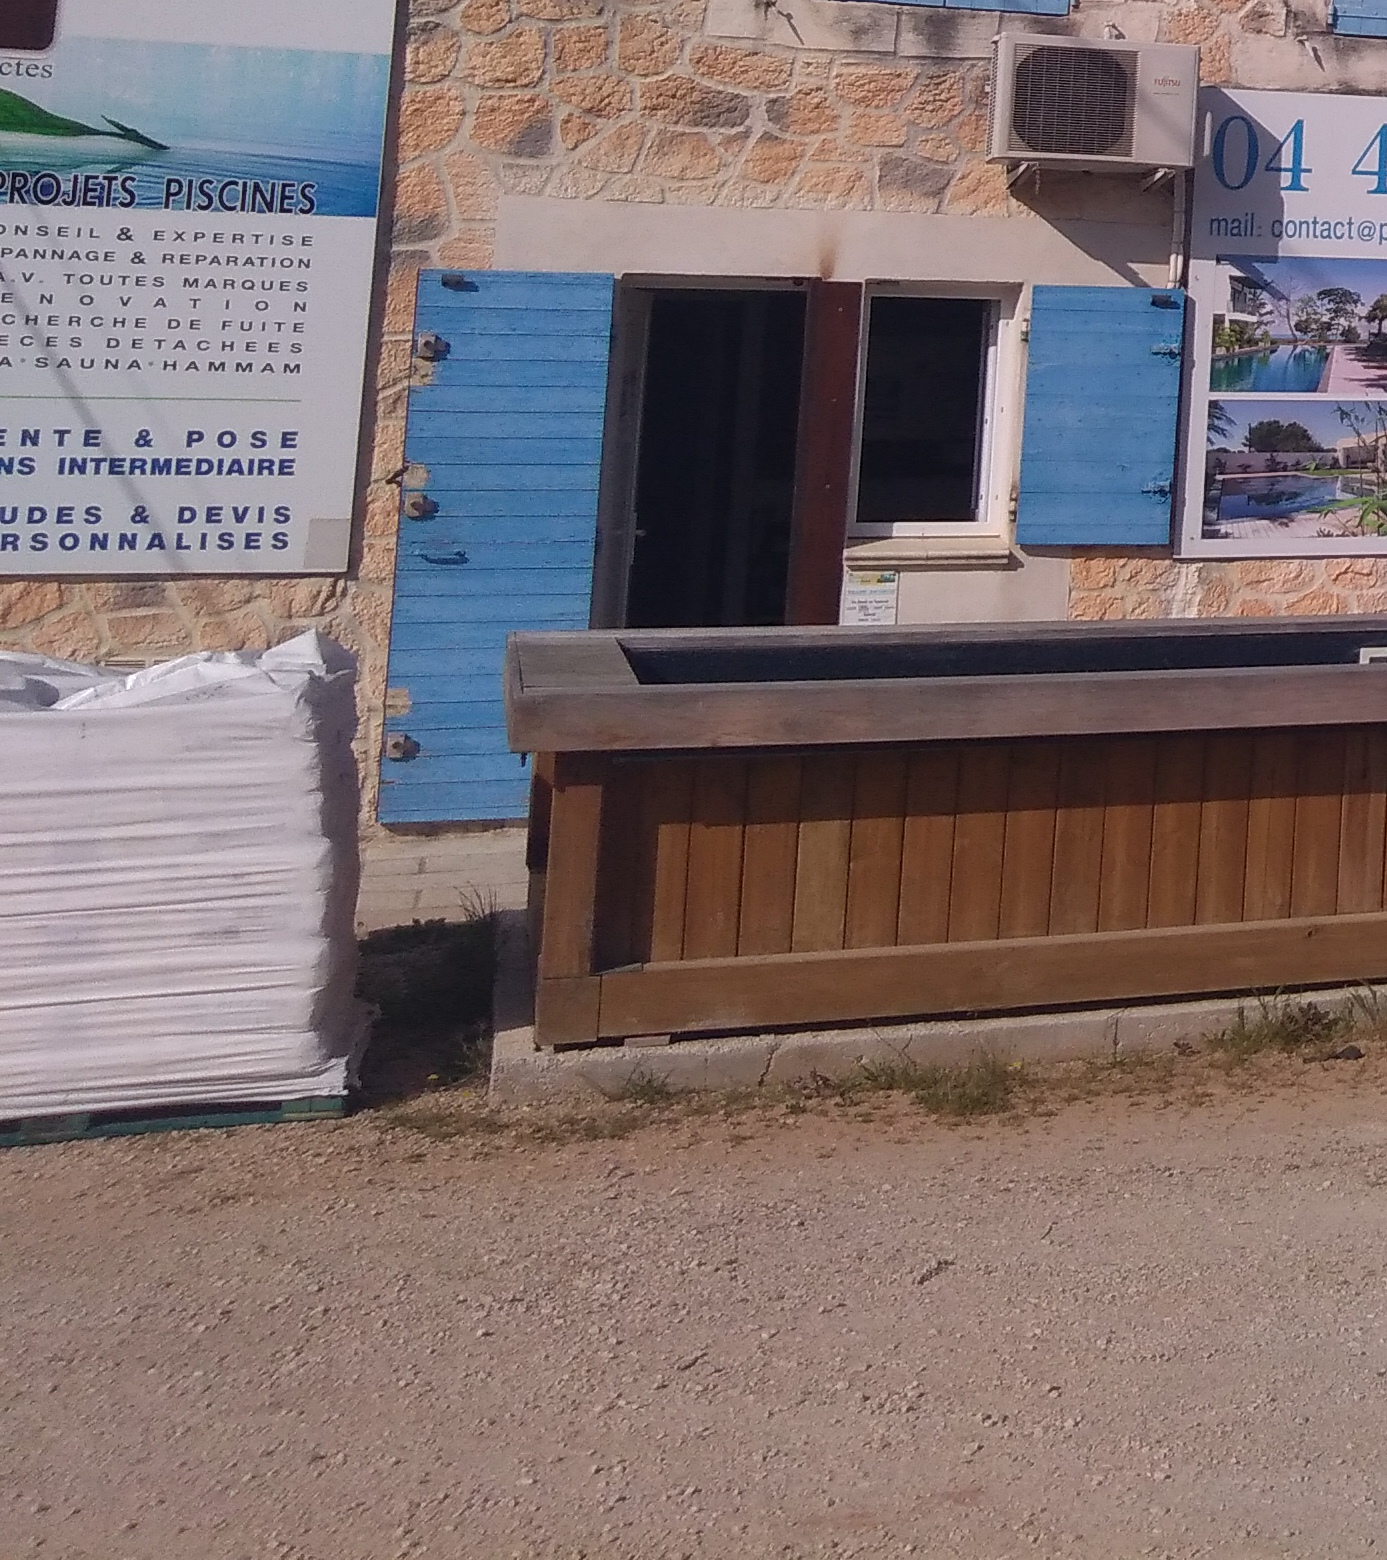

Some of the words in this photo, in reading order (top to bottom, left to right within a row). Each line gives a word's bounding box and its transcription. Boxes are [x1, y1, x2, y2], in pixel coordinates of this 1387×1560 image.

[1212, 115, 1312, 192] 04
[163, 177, 317, 215] PISCINES
[1210, 213, 1263, 237] mail:
[117, 227, 134, 242] &
[153, 229, 314, 247] EXPERTISE
[1, 247, 116, 262] PANNAGE
[130, 251, 146, 265] &
[162, 253, 312, 269] REPARATION
[63, 273, 166, 288] TOUTES
[182, 277, 309, 292] MARQUES
[1, 314, 147, 329] CHERCHE
[167, 318, 201, 331] DE
[221, 321, 305, 333] FUITE
[106, 337, 303, 354] DETACHEES
[134, 429, 153, 448] &
[185, 430, 299, 449] POSE
[57, 456, 296, 477] INTERMEDIAIRE
[130, 505, 150, 524] &
[177, 505, 291, 524] DEVIS
[0, 531, 290, 551] RSONNALISES
